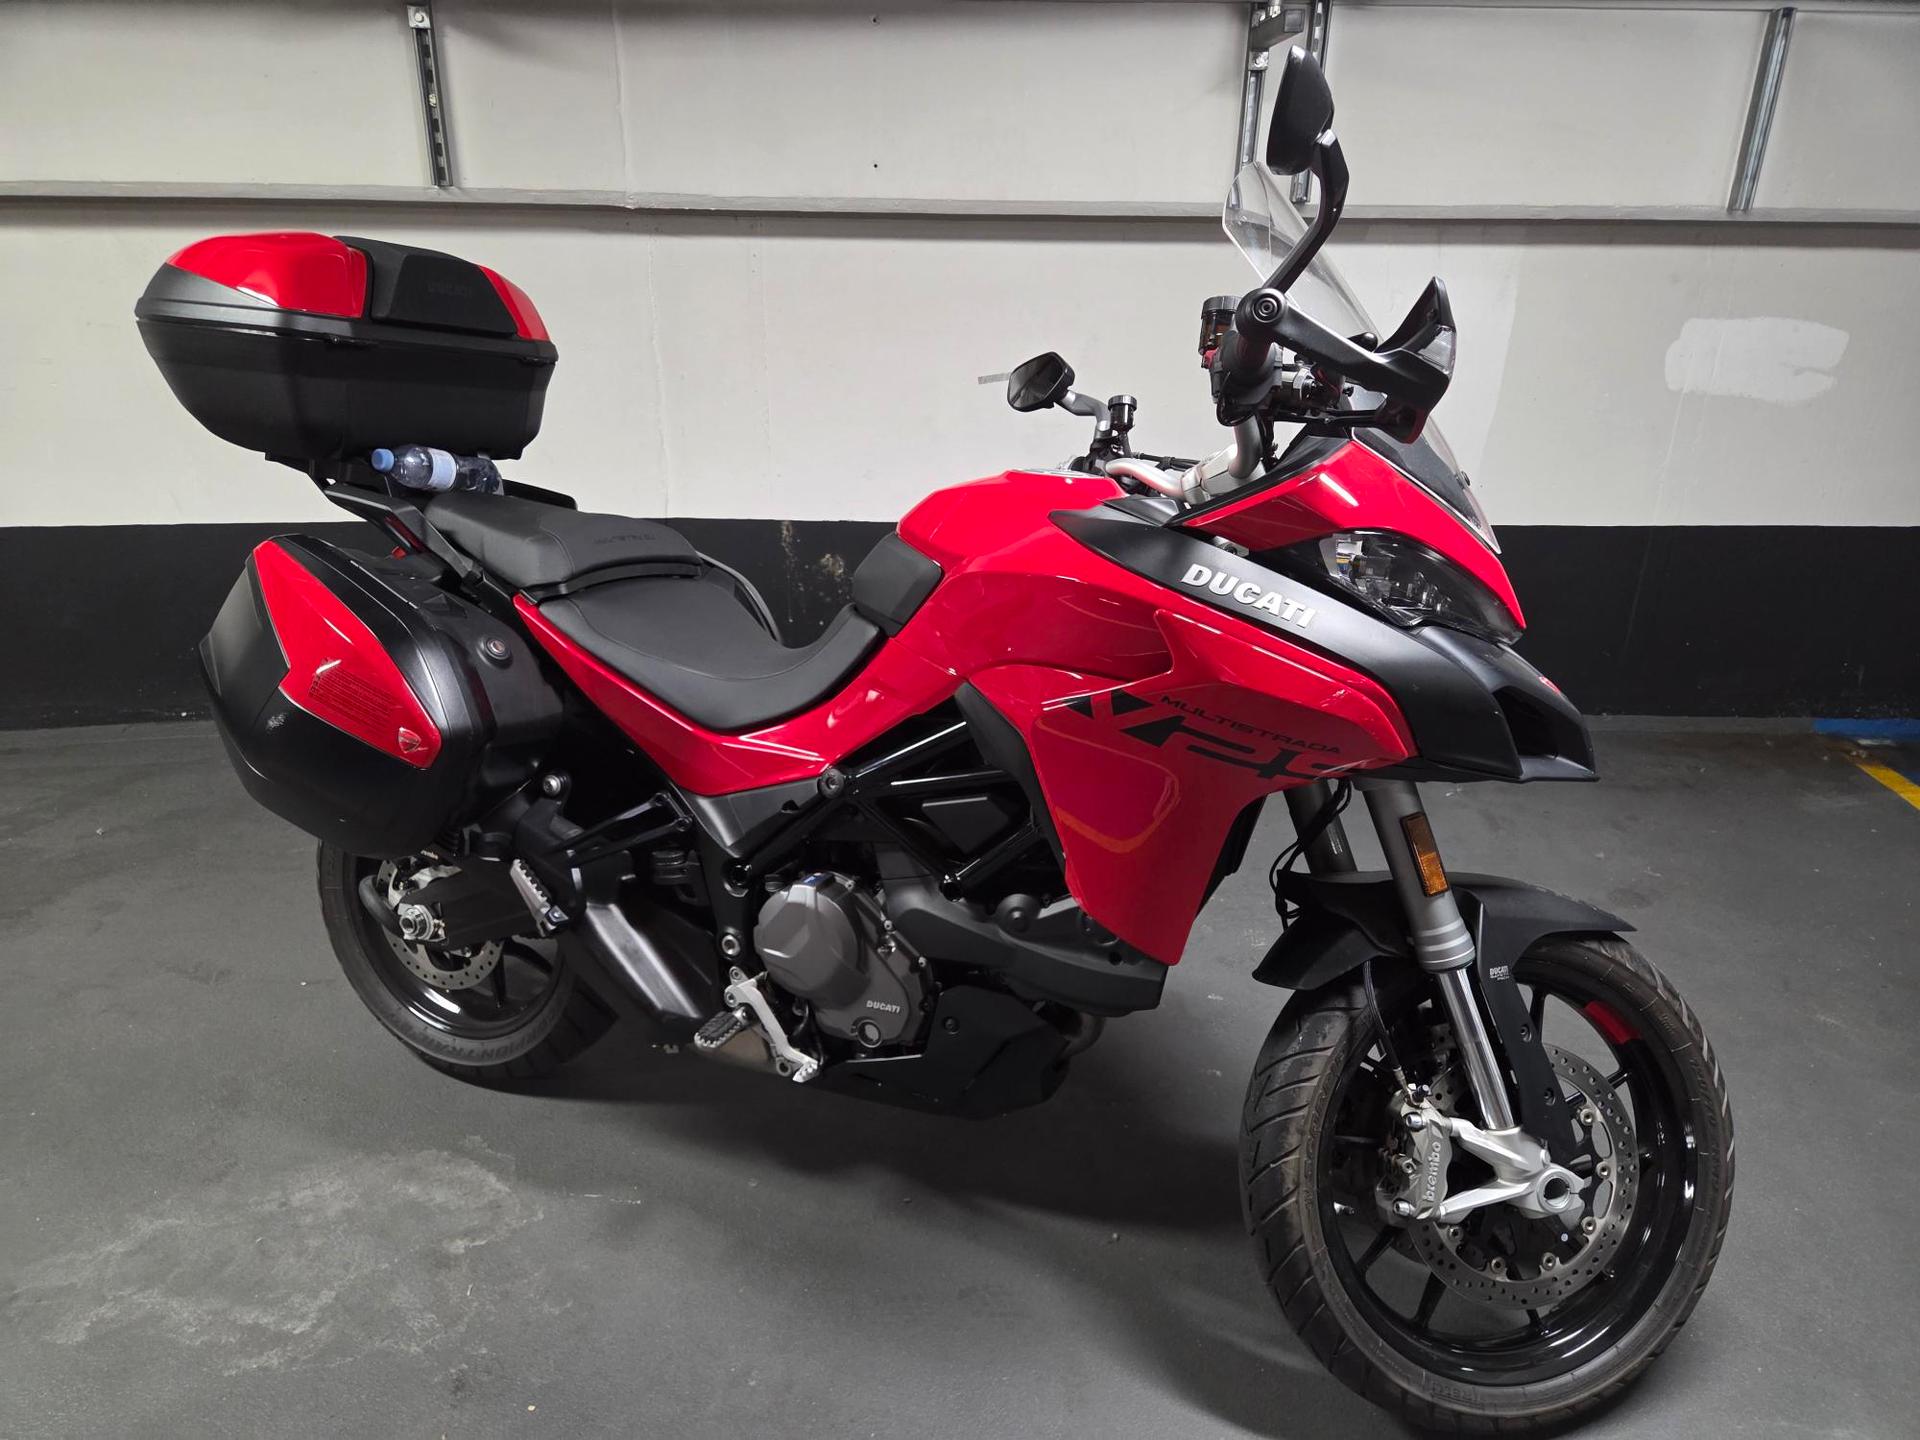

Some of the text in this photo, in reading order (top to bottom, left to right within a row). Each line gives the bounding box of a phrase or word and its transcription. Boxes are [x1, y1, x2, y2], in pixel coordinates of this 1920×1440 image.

[1181, 563, 1316, 628] DUCATI
[1160, 695, 1341, 754] MULTISTRADA
[865, 1000, 900, 1014] DUCATI
[1422, 1141, 1441, 1202] brembo
